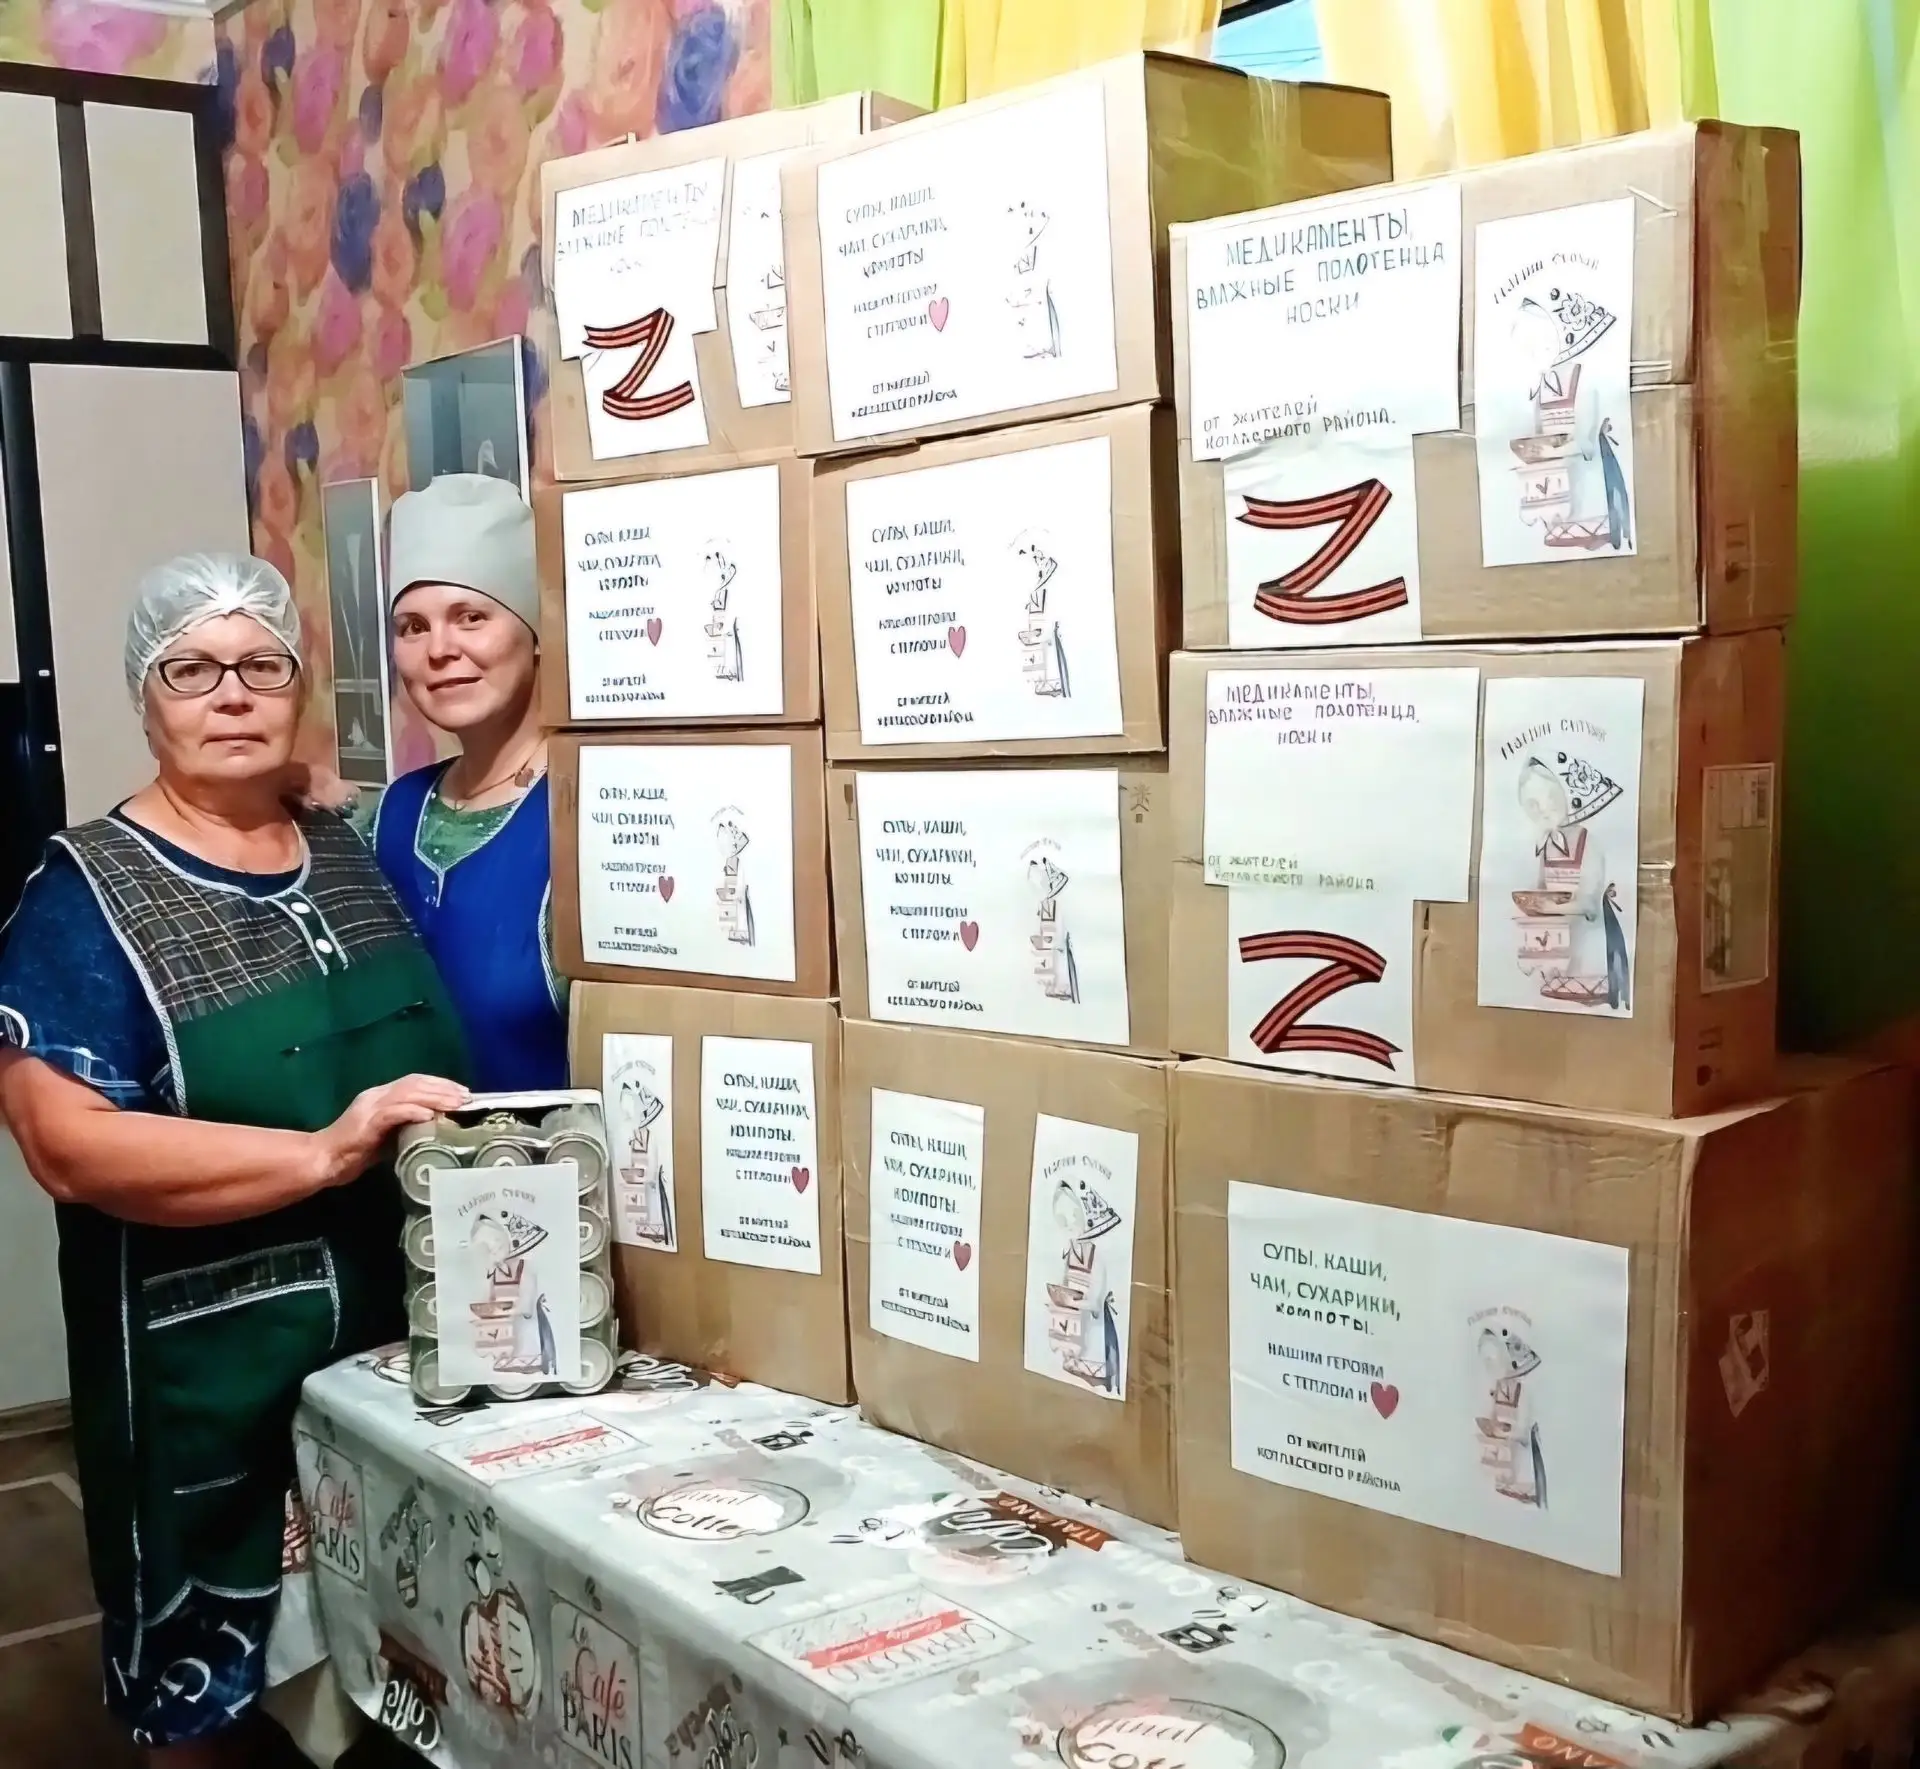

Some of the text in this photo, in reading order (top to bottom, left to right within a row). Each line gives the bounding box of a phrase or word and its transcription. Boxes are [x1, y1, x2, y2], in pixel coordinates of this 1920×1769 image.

[1287, 292, 1359, 324] НОСКИ
[1203, 415, 1220, 432] ОТ
[1262, 1242, 1388, 1283] СУПЫ, КАШИ,
[1296, 1282, 1401, 1321] СУХАРИКИ,
[1268, 1342, 1385, 1379] НАШИМ ГЕРОЯМ
[1293, 1374, 1354, 1400] ТЕПЛОМ
